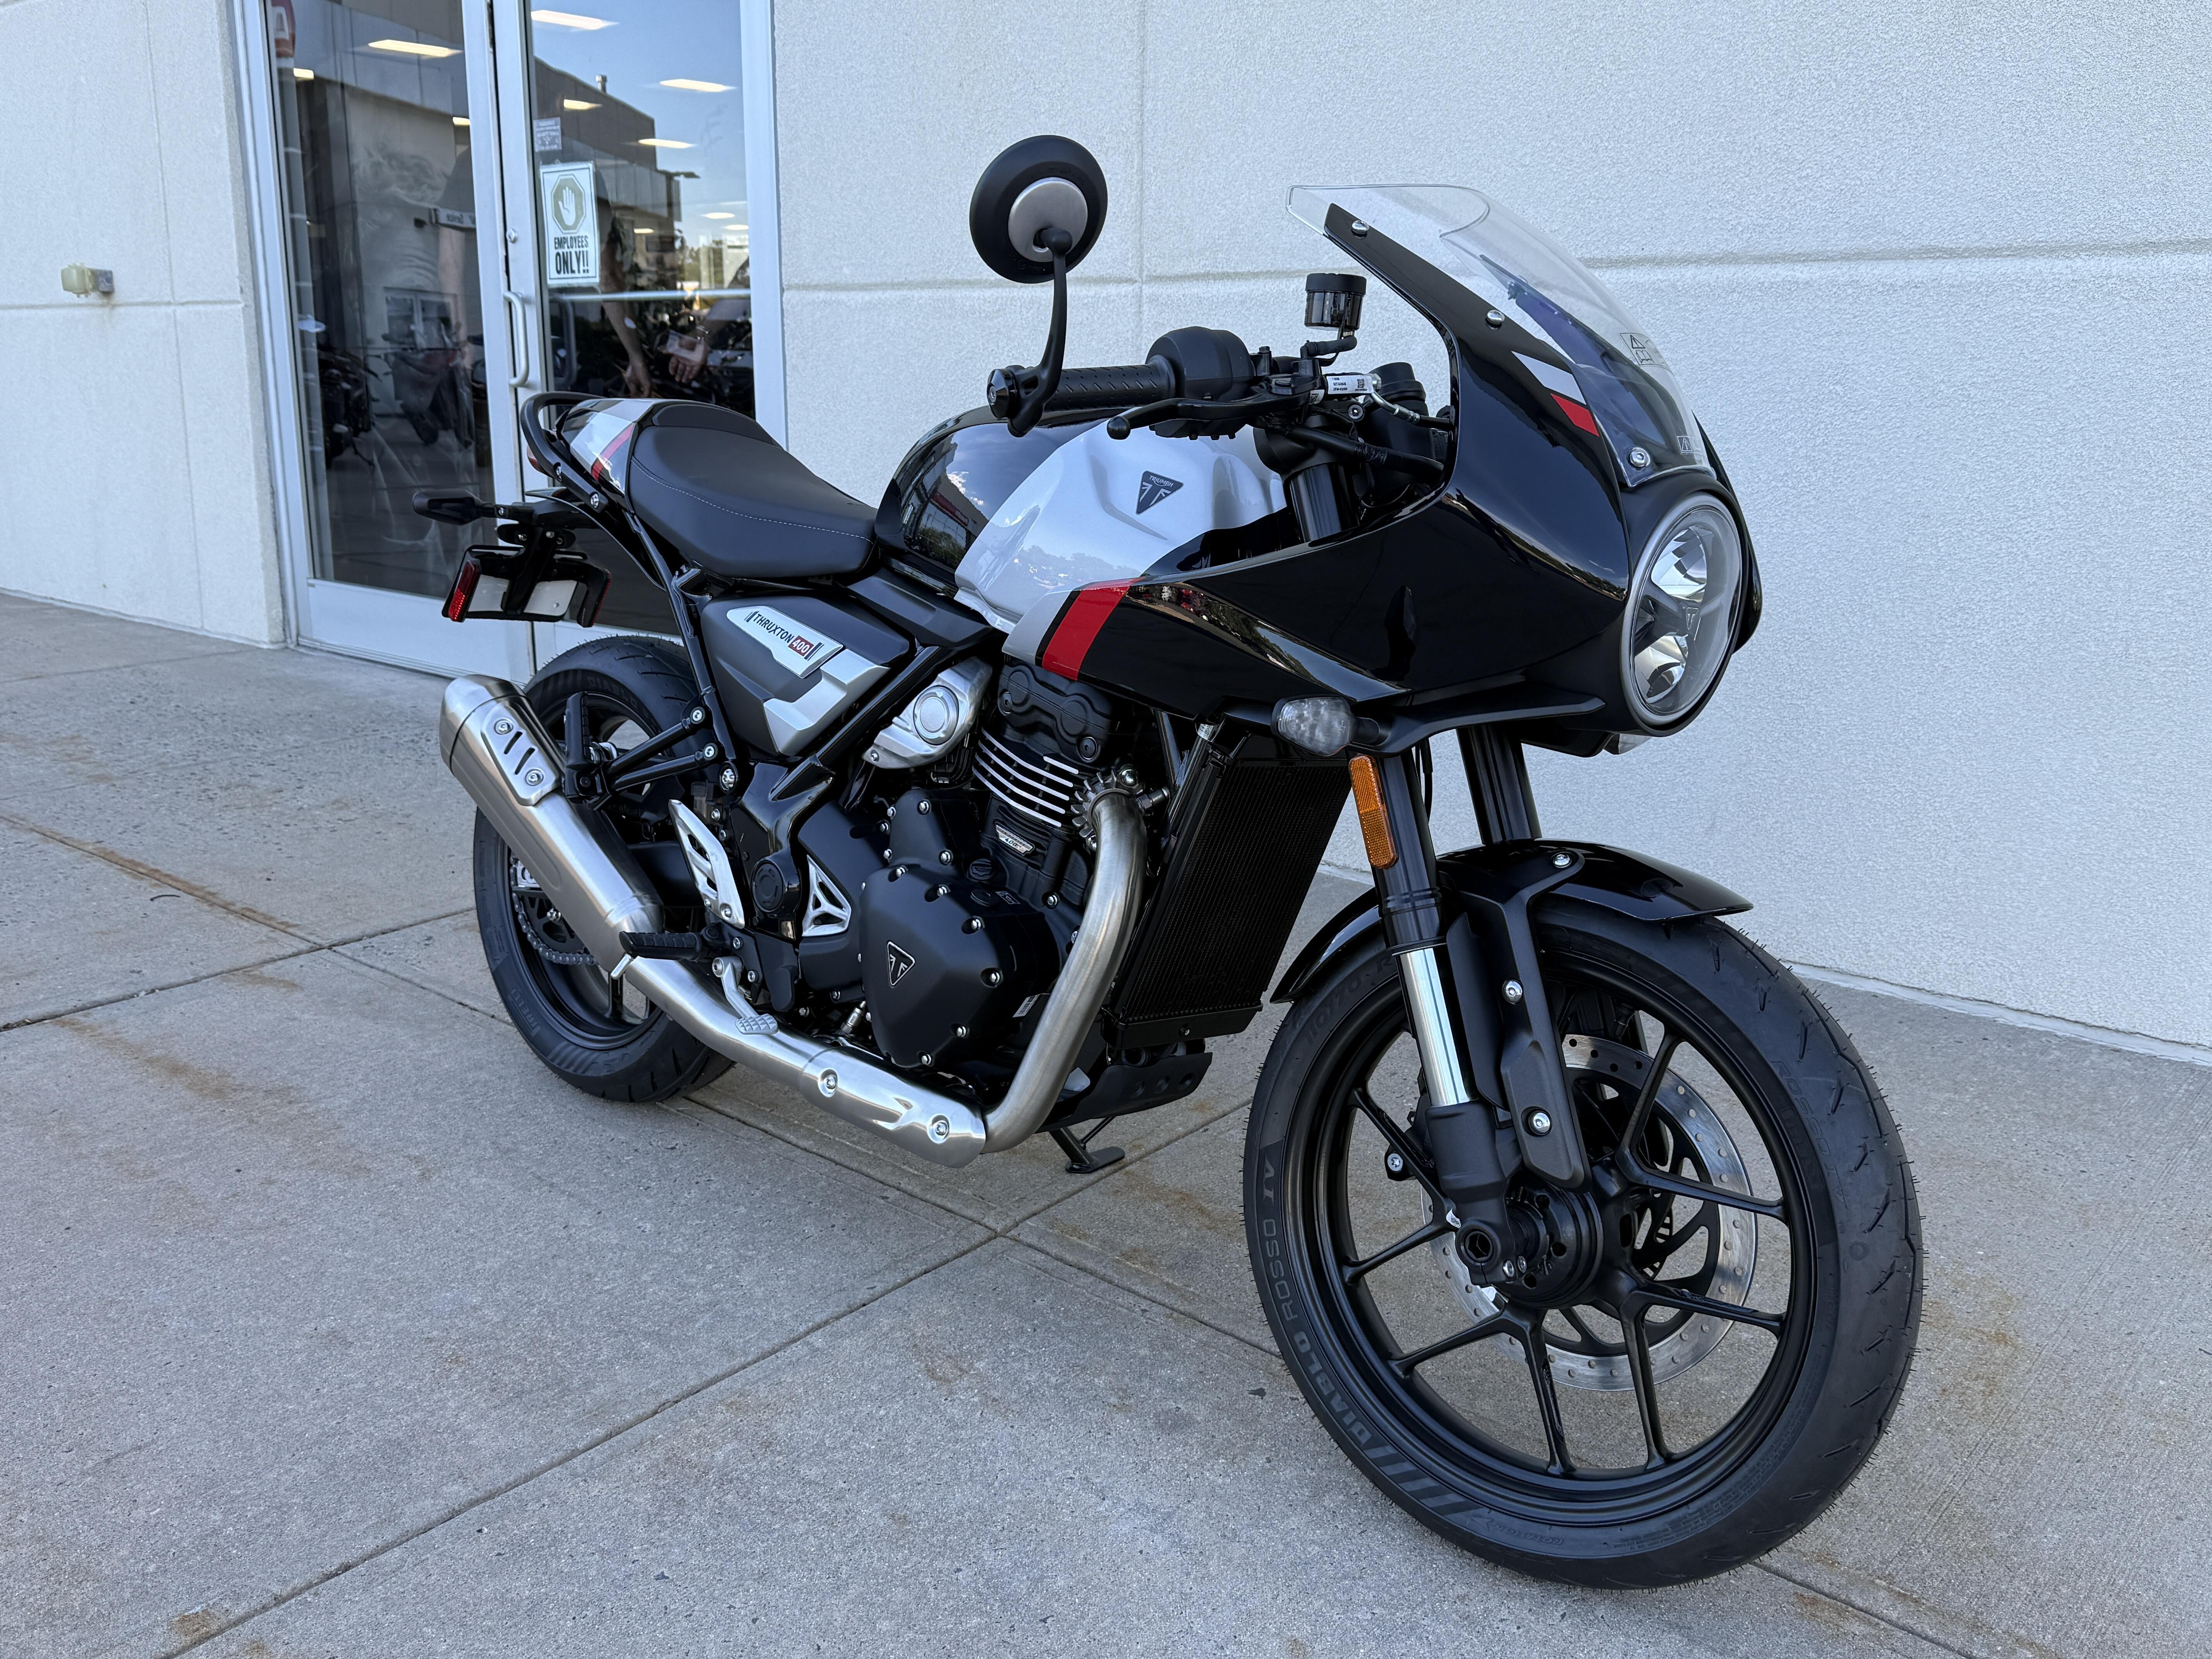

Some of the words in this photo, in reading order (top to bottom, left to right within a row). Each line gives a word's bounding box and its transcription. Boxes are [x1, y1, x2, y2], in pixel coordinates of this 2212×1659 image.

[554, 235, 589, 250] EMPLOYEES
[556, 250, 589, 275] ONLY!!
[1149, 475, 1173, 487] TRIUMPH
[753, 613, 794, 644] THRUXTON
[792, 639, 810, 654] 400
[586, 676, 638, 710] DIABLO
[507, 987, 542, 1037] PIRELLI
[1263, 1152, 1276, 1206] IV
[1262, 1218, 1299, 1322] ROSSO
[1293, 1329, 1373, 1447] DIABLO
[1493, 1523, 1565, 1546] ROTATION
